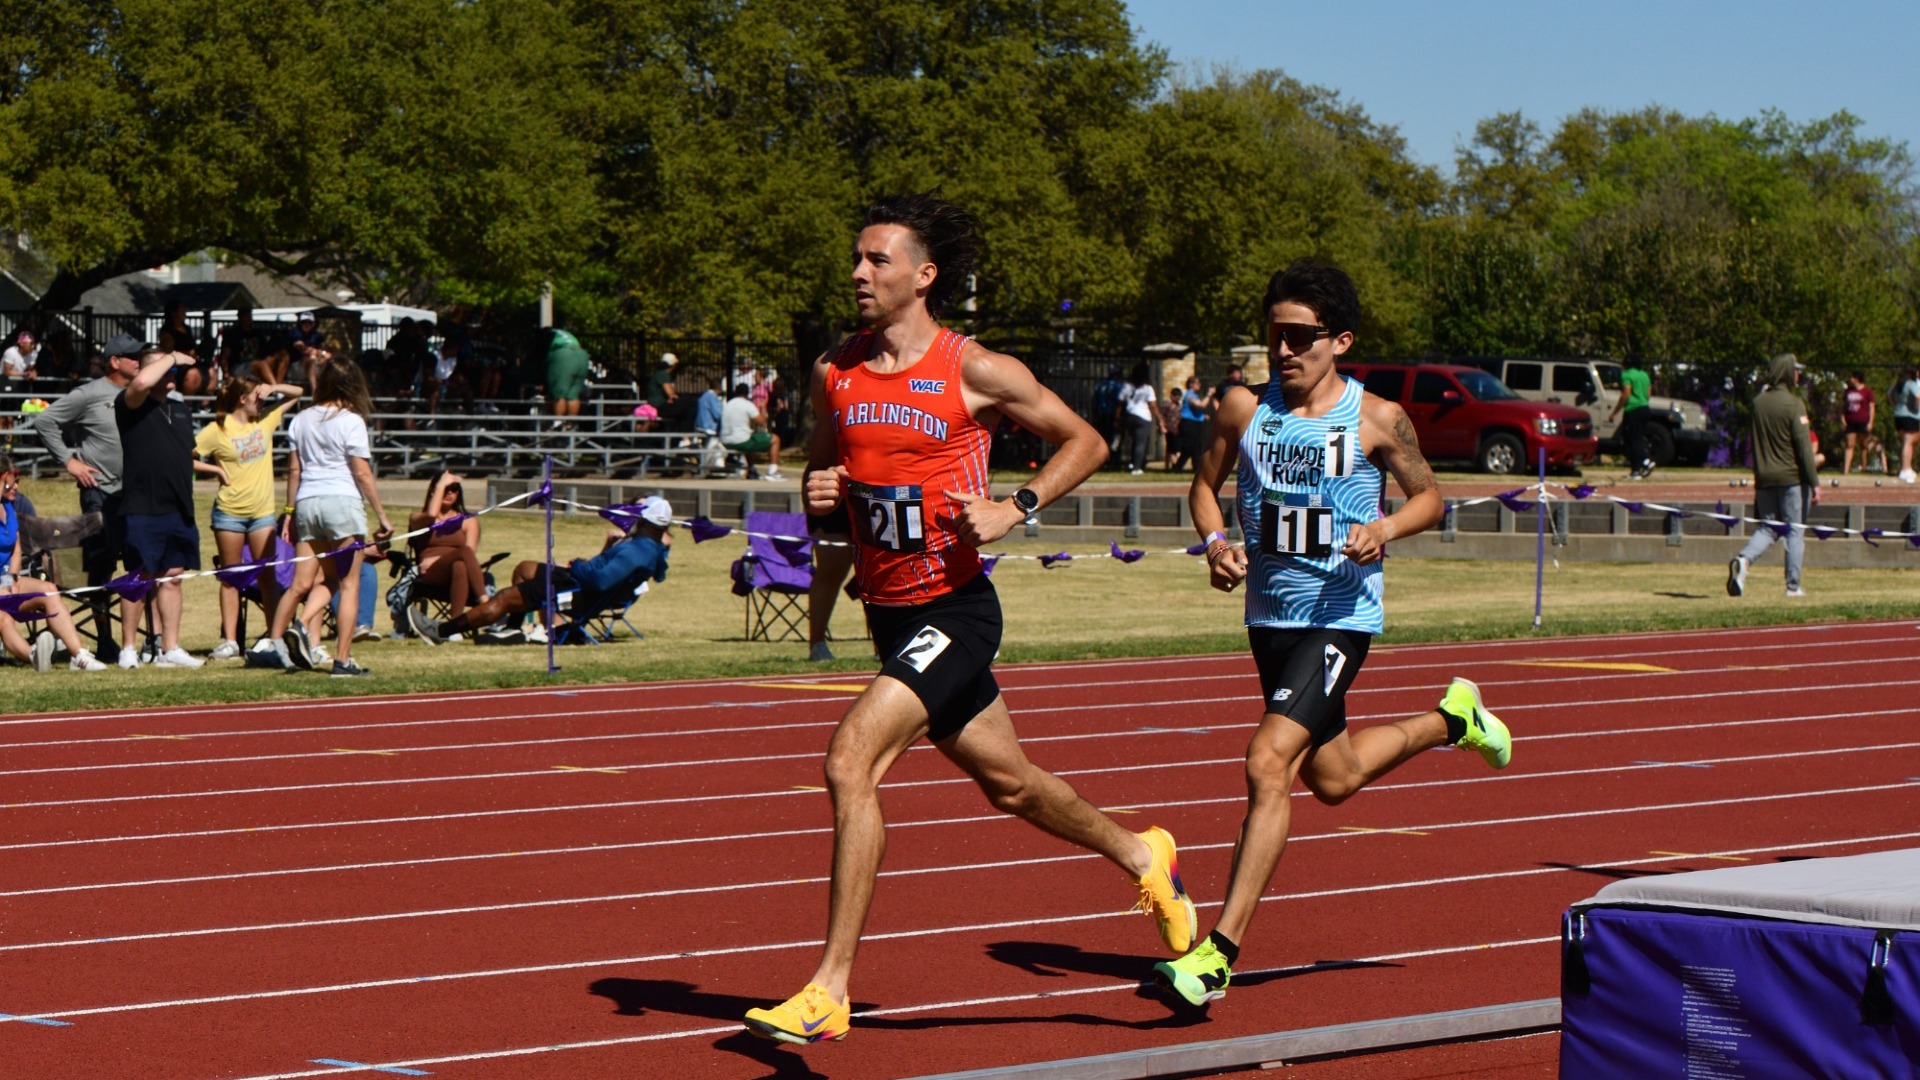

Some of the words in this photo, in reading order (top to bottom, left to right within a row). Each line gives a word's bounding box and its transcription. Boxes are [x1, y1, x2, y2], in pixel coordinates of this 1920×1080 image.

[908, 379, 946, 394] WAC
[845, 401, 949, 442] ARLINGTON
[1257, 441, 1325, 467] THUNDE
[1329, 434, 1346, 477] 1
[1272, 463, 1320, 487] ROAD
[870, 502, 893, 549] 2
[1282, 510, 1298, 552] 1
[899, 629, 939, 667] 2
